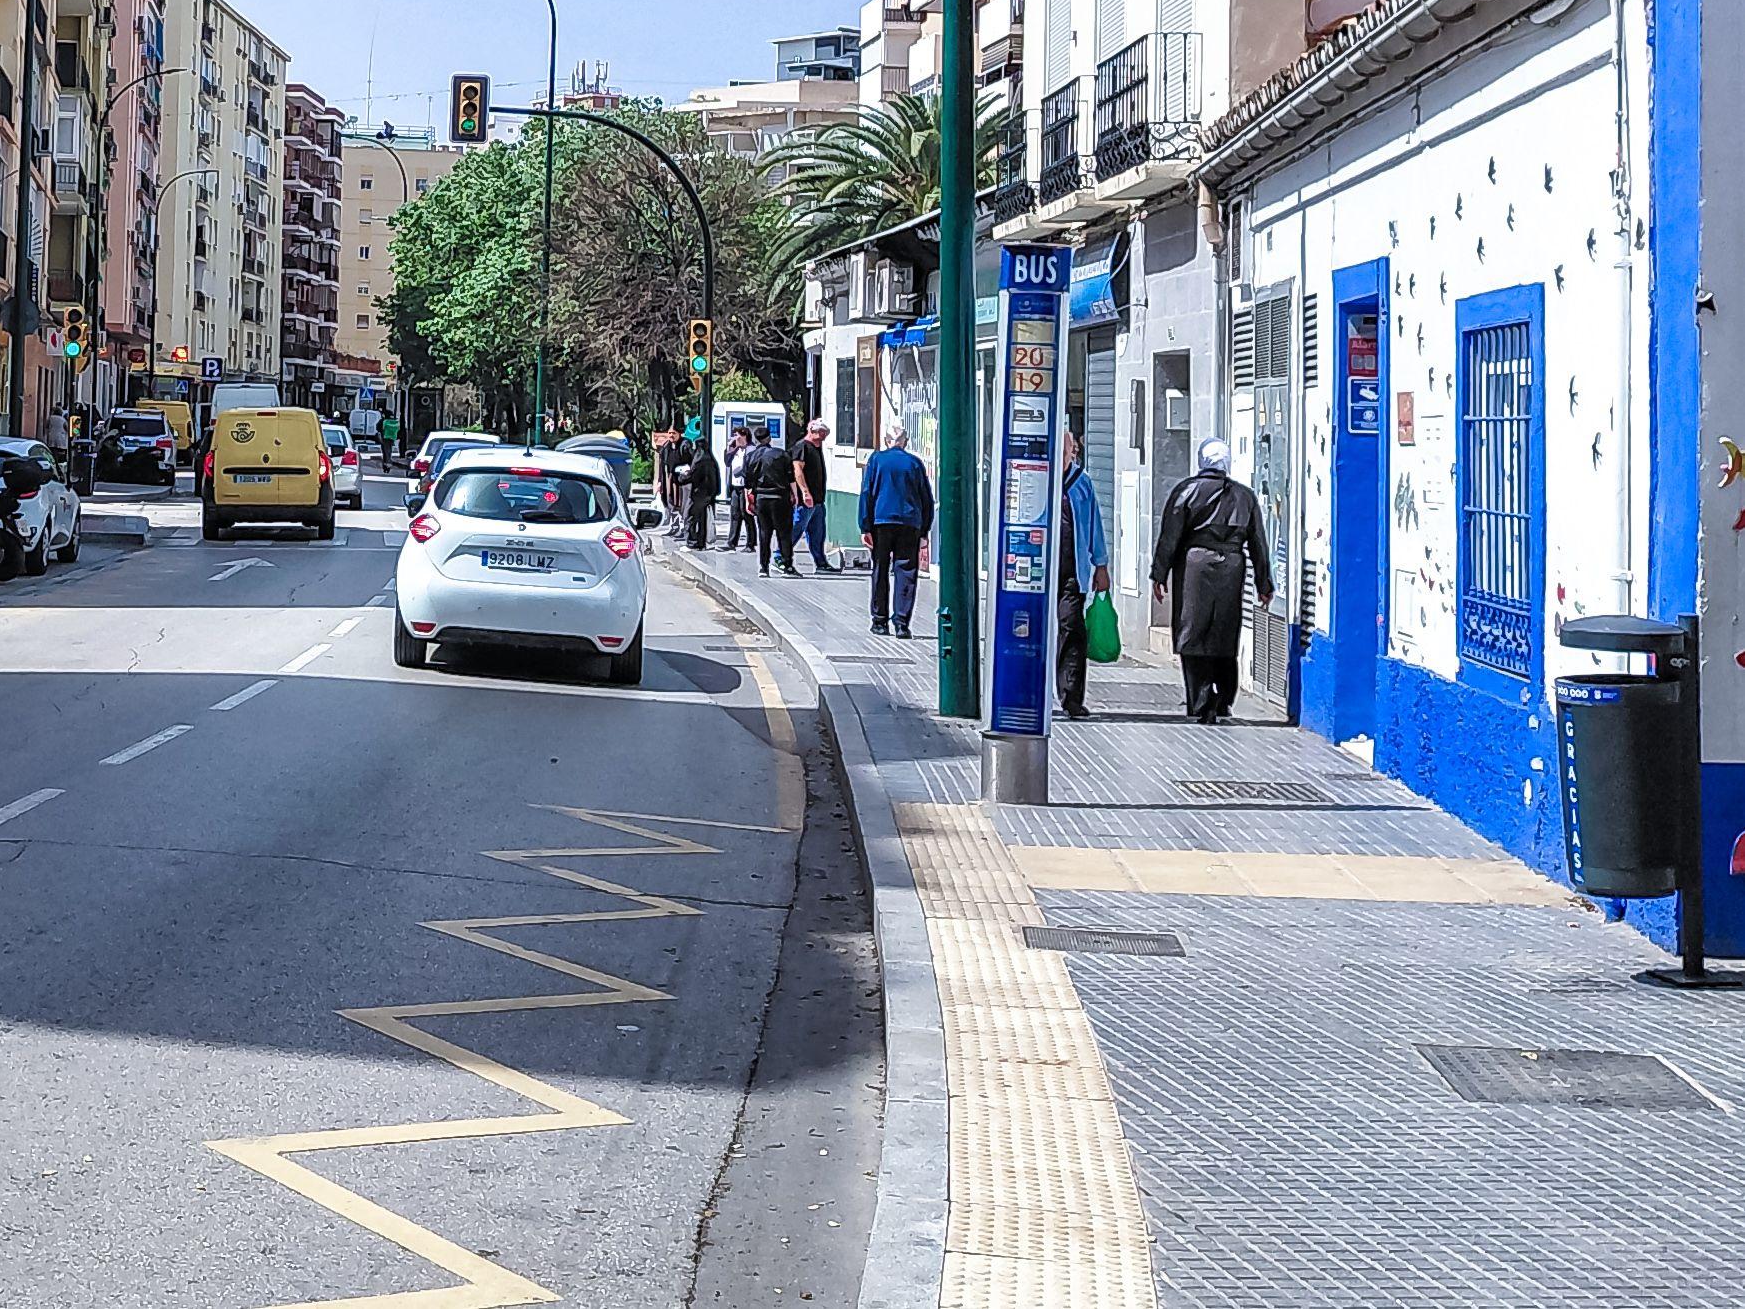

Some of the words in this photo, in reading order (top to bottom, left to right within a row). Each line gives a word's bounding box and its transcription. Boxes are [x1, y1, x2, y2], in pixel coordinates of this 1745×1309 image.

[1015, 254, 1058, 284] BUS
[1015, 347, 1044, 367] 20
[1016, 372, 1044, 392] 19
[490, 552, 524, 566] 9208
[1565, 721, 1582, 869] GRACIAS
